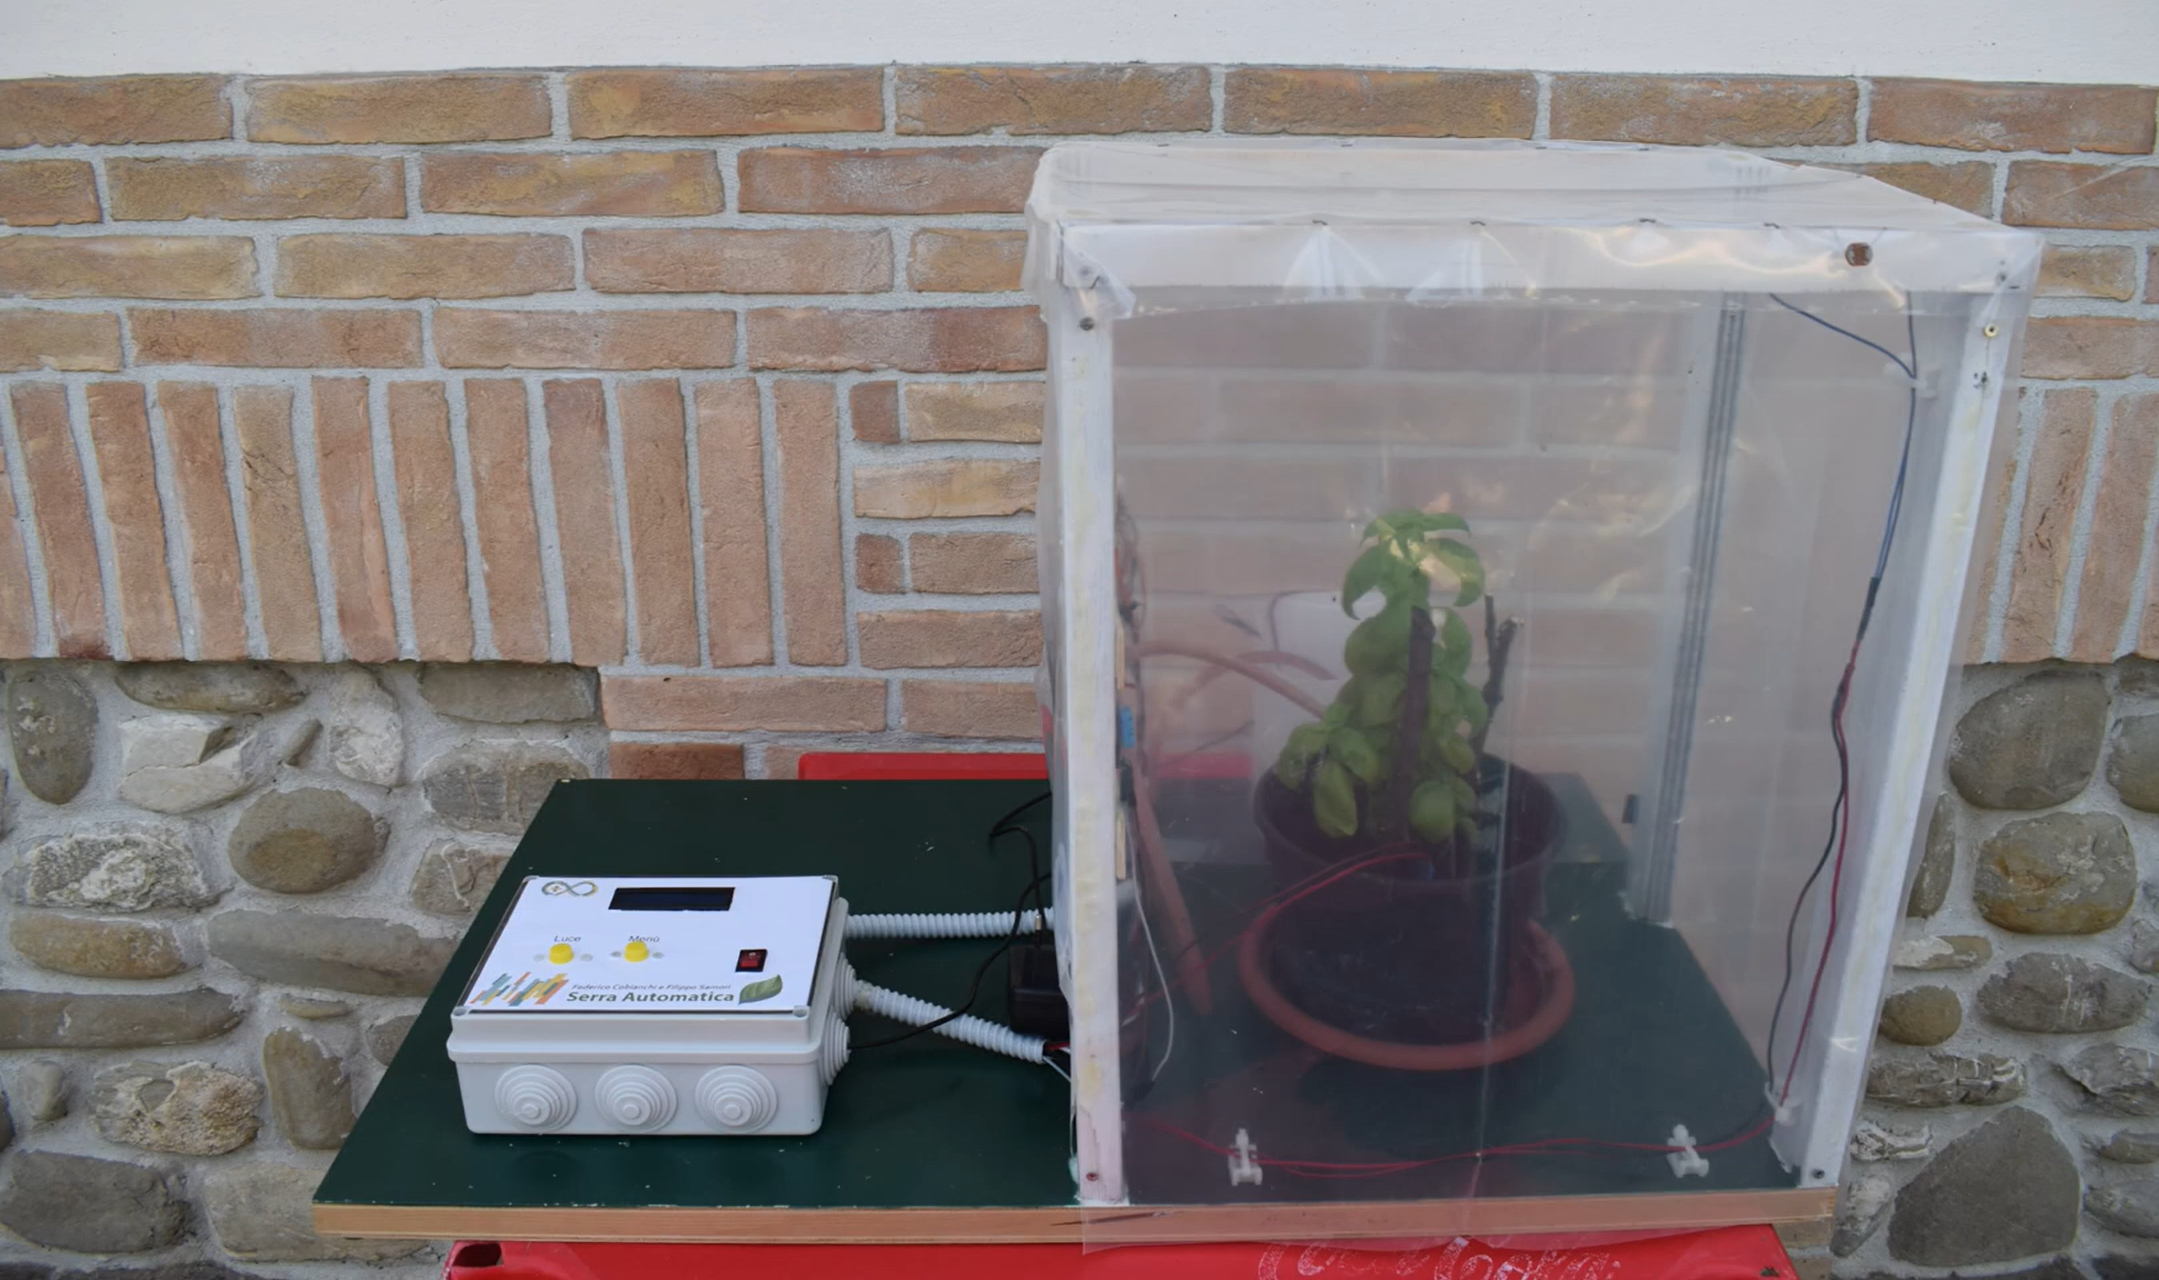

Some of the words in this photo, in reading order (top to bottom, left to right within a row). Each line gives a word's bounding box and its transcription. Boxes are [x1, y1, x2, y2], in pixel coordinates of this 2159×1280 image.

[554, 935, 582, 943] Luce
[567, 991, 617, 1002] Serra
[621, 991, 734, 1002] Automatica
